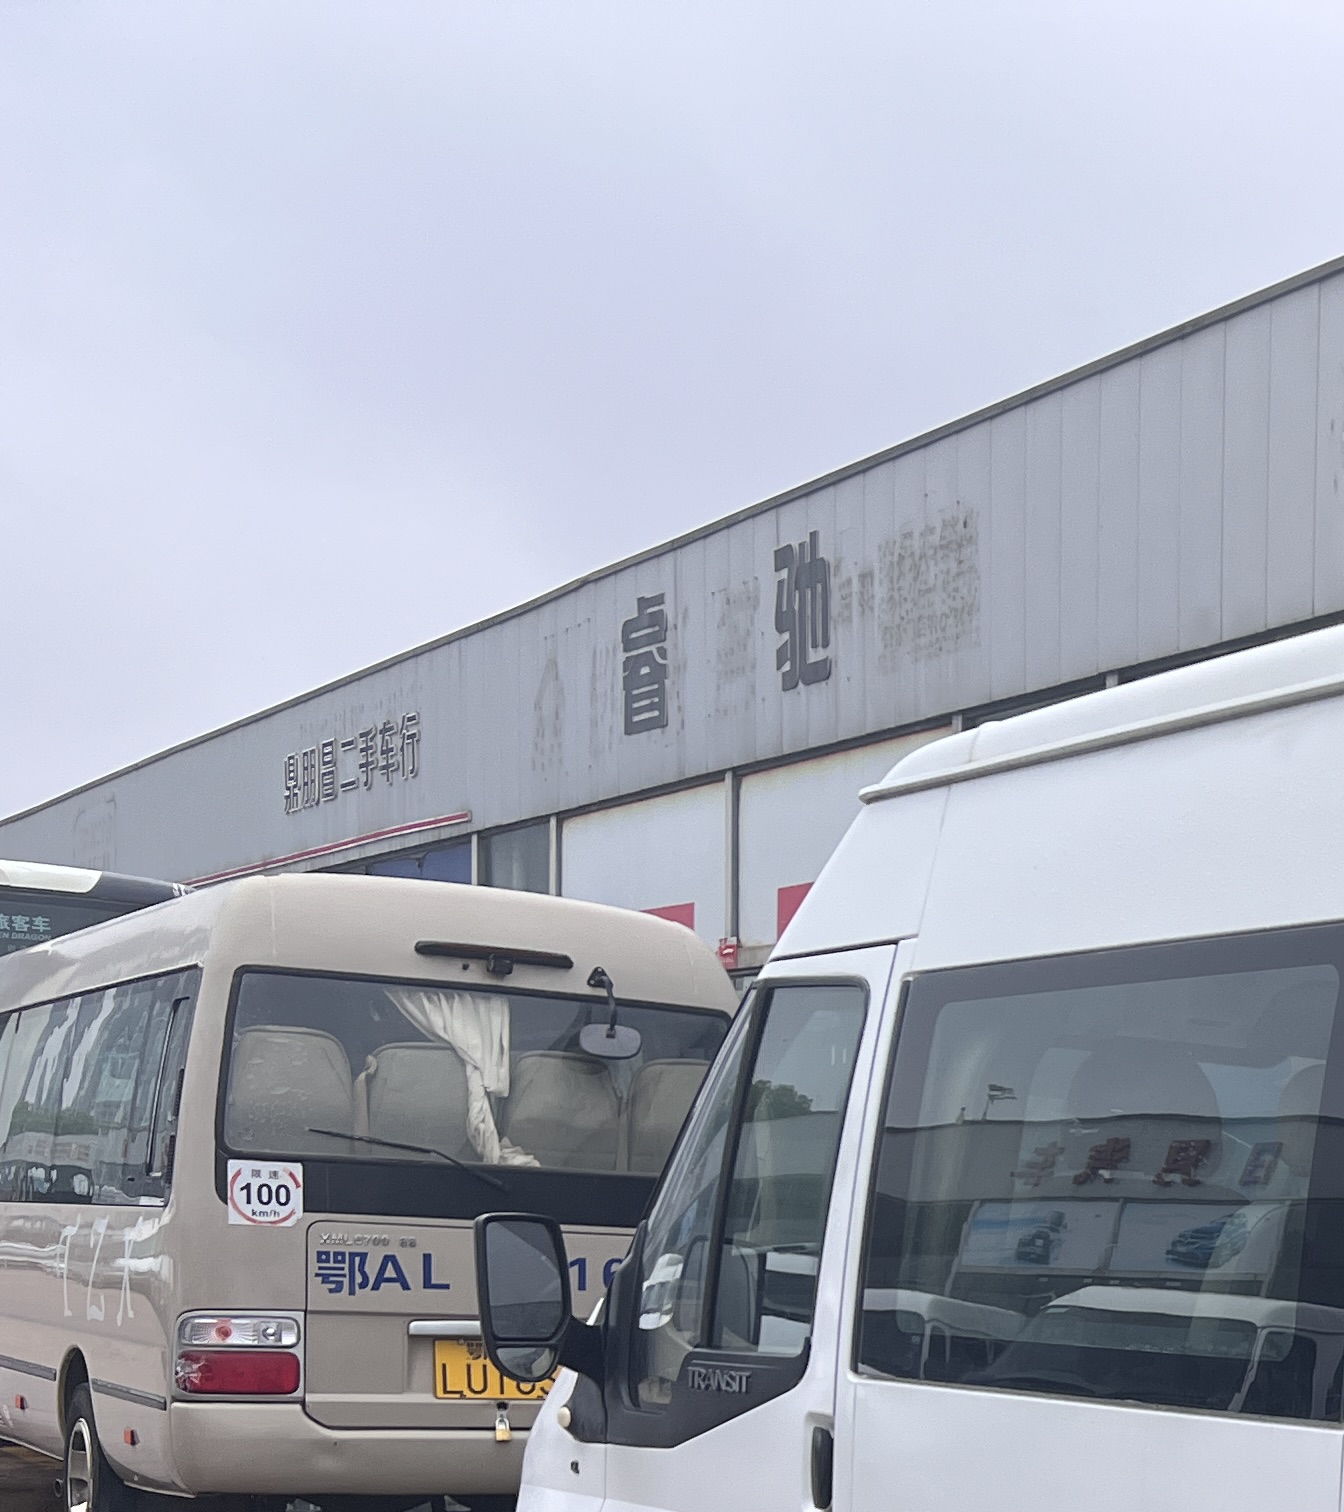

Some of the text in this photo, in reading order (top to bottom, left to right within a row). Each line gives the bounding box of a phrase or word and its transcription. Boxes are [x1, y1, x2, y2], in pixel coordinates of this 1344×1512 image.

[251, 1168, 280, 1180] 限速
[240, 1182, 291, 1207] 100
[251, 1208, 280, 1219] km/h
[687, 1366, 752, 1393] TRANSIT
